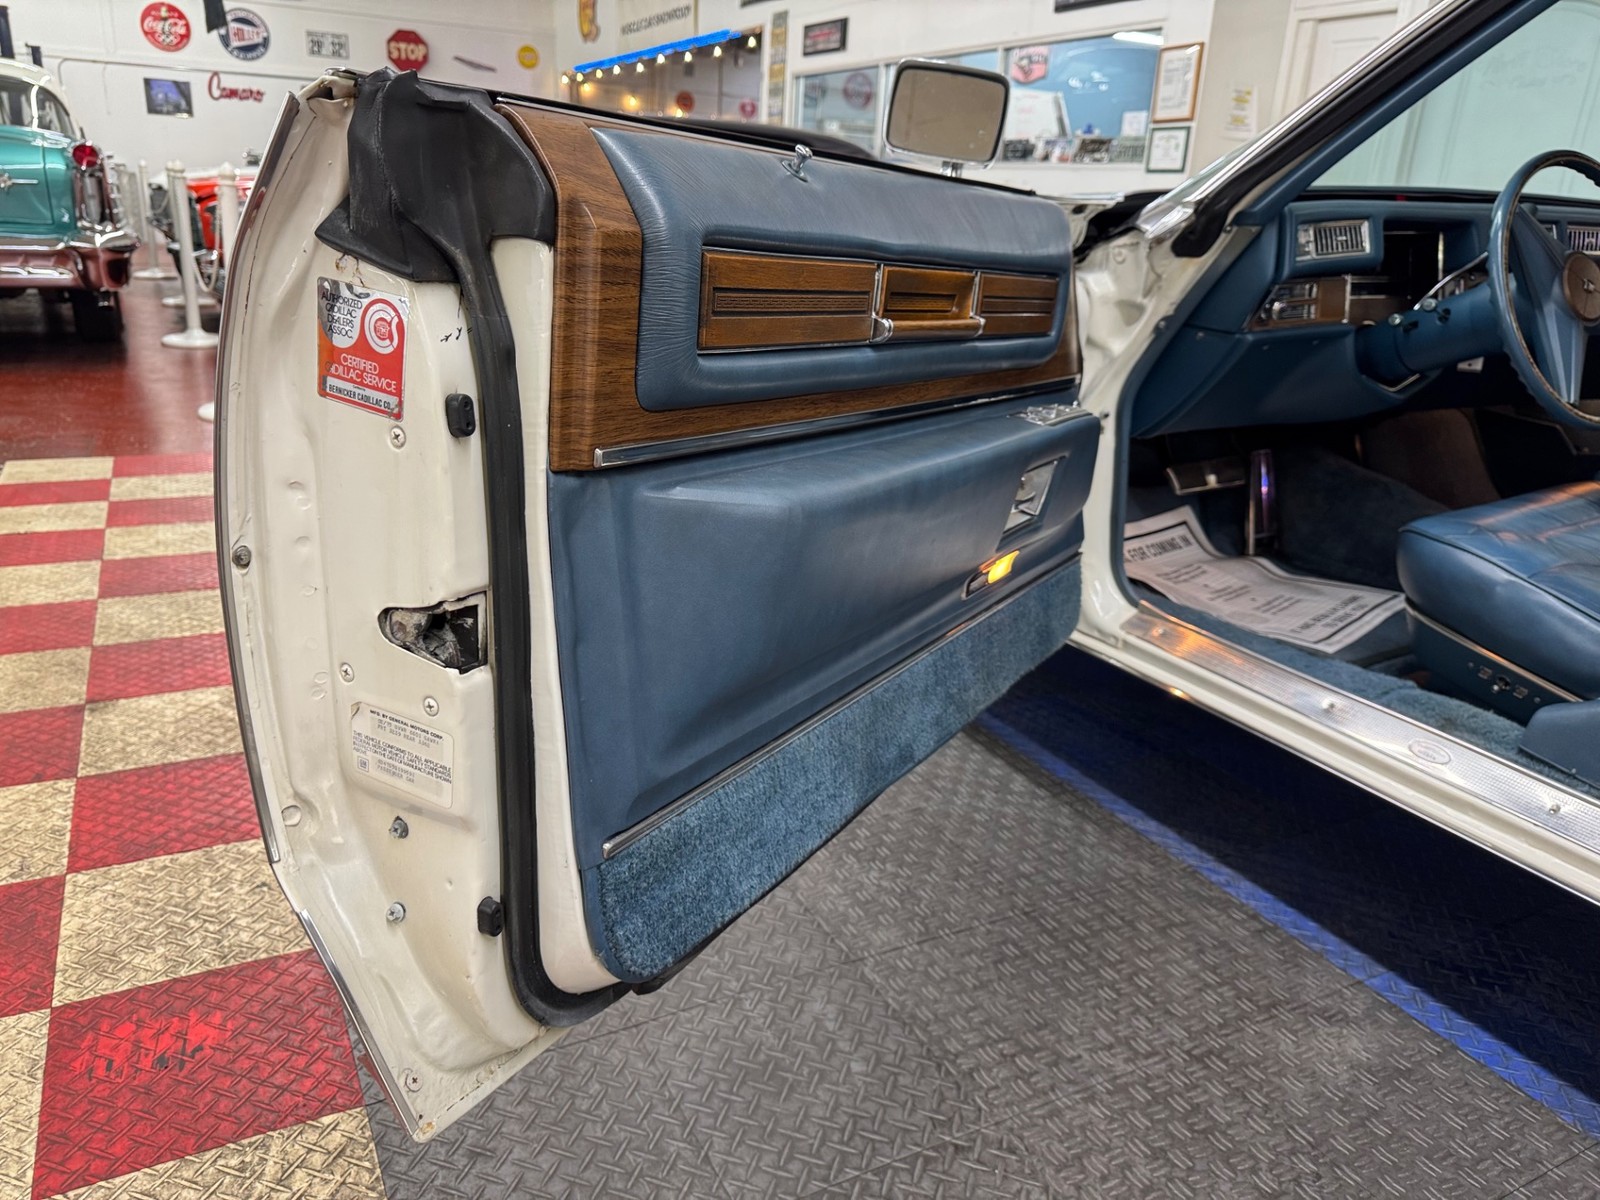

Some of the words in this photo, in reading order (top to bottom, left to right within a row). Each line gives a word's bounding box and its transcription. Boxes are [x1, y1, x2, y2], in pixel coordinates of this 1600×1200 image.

[389, 40, 427, 62] STOP
[208, 71, 266, 103] Camaro
[321, 291, 363, 310] AUTHORIZED
[325, 302, 357, 319] CADILLAC
[327, 313, 355, 329] DEALERS
[340, 353, 380, 375] CERTIFIED
[362, 372, 397, 393] SERVICE
[356, 392, 383, 408] CADILLAC
[388, 716, 409, 728] GENERAL
[409, 723, 430, 735] MOTORS
